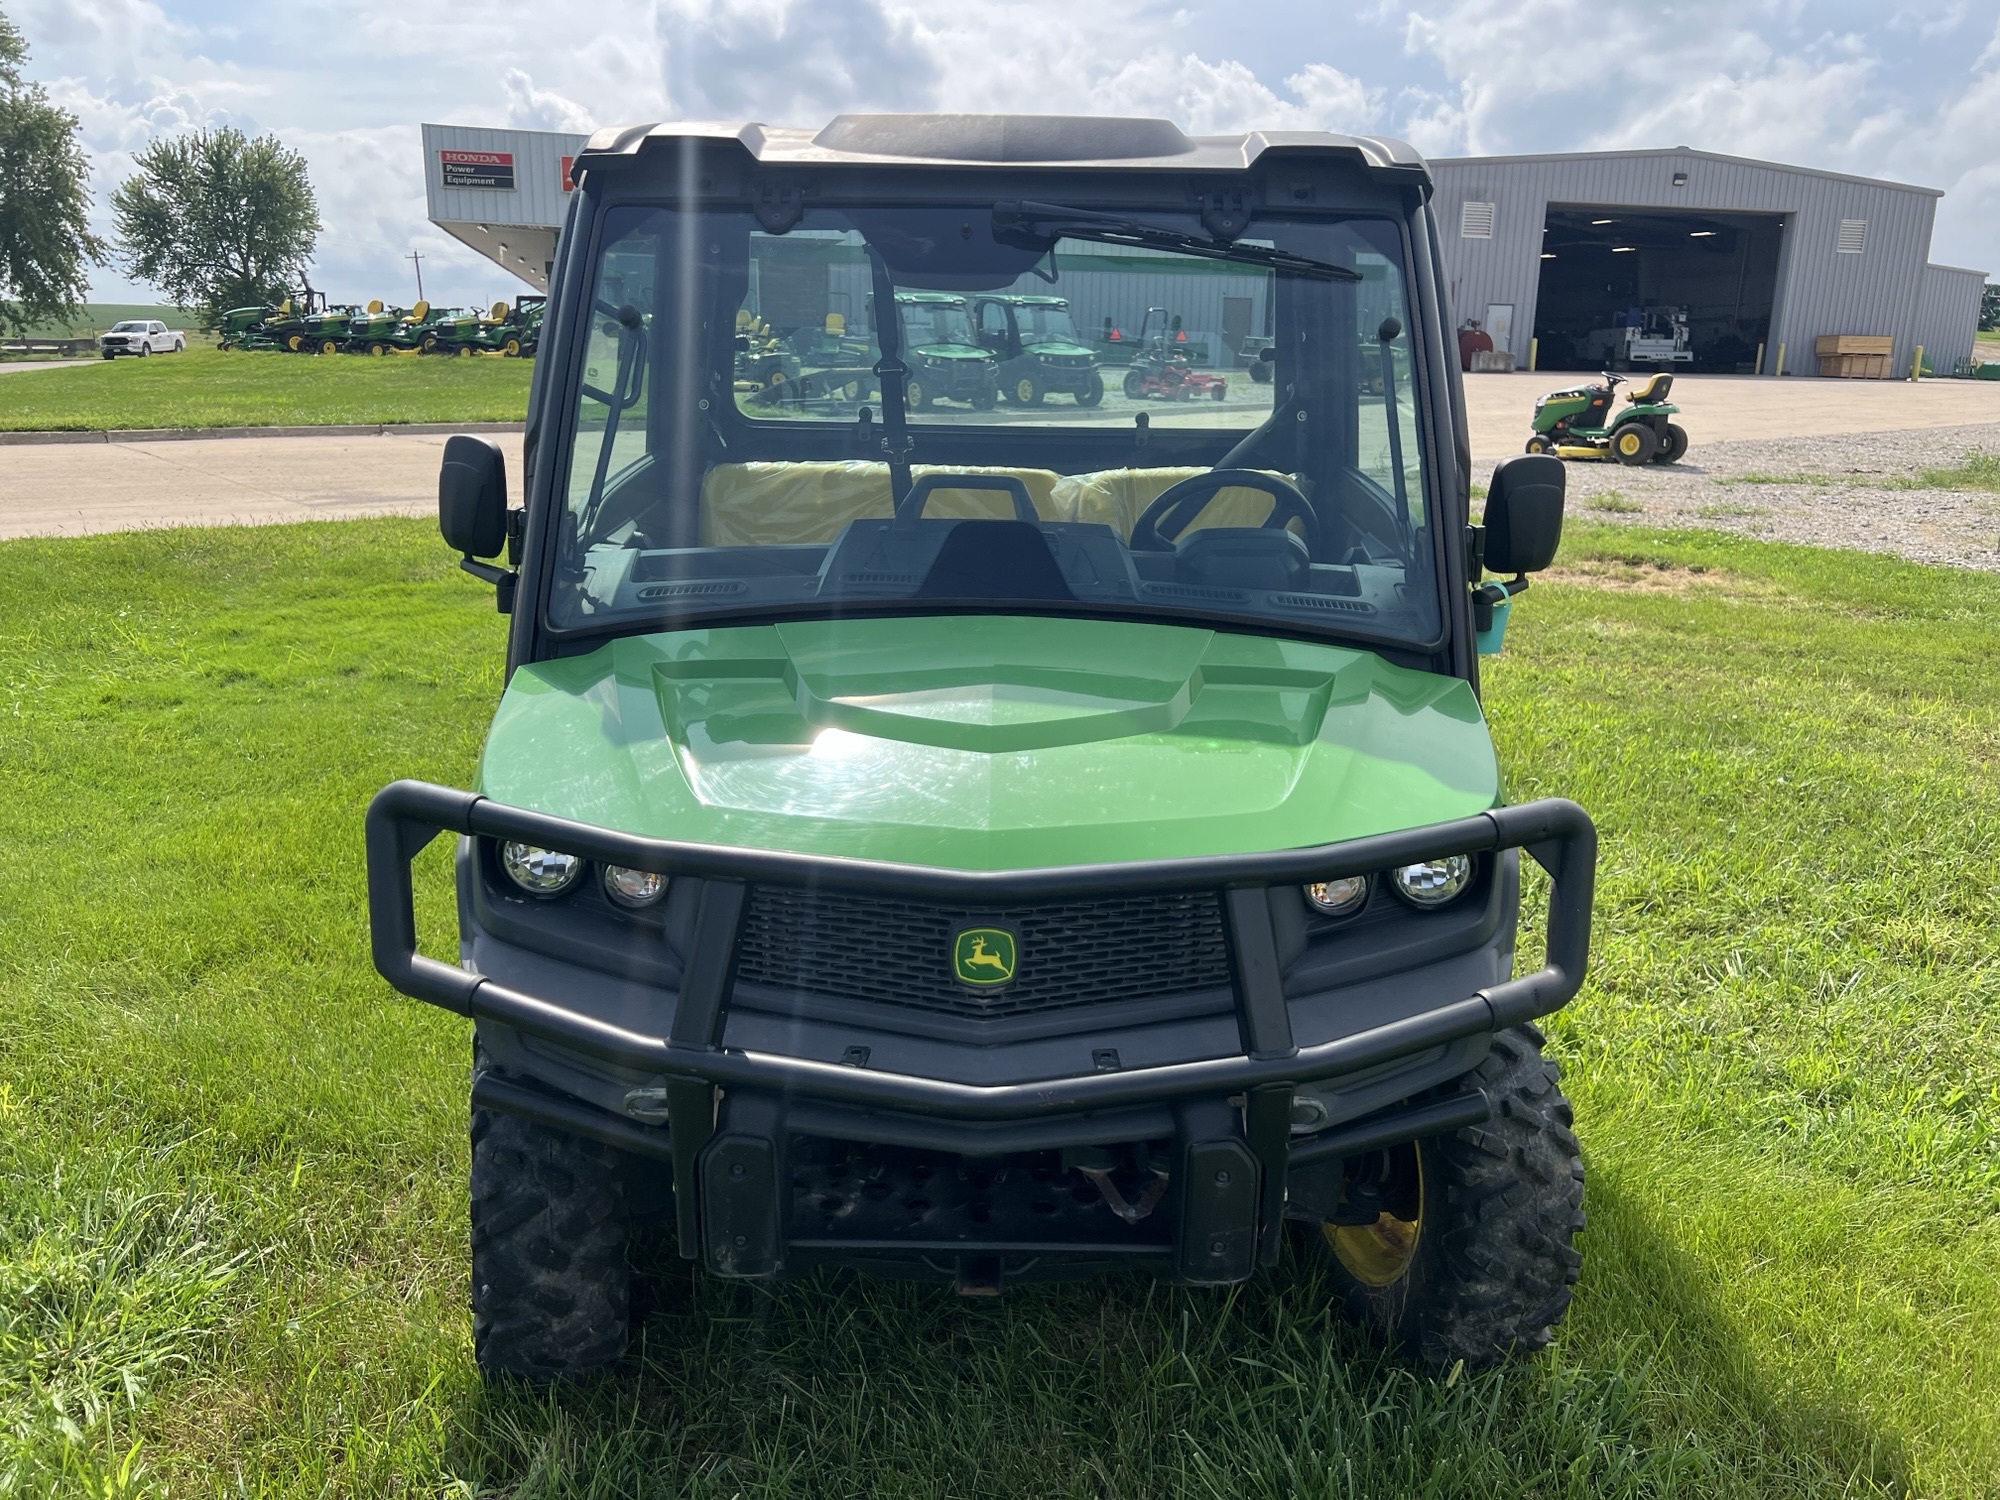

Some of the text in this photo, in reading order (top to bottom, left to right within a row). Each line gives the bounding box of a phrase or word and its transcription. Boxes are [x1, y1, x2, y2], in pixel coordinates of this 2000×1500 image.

[445, 152, 501, 163] HONDA
[446, 164, 475, 173] Power
[447, 175, 495, 185] Equipment
